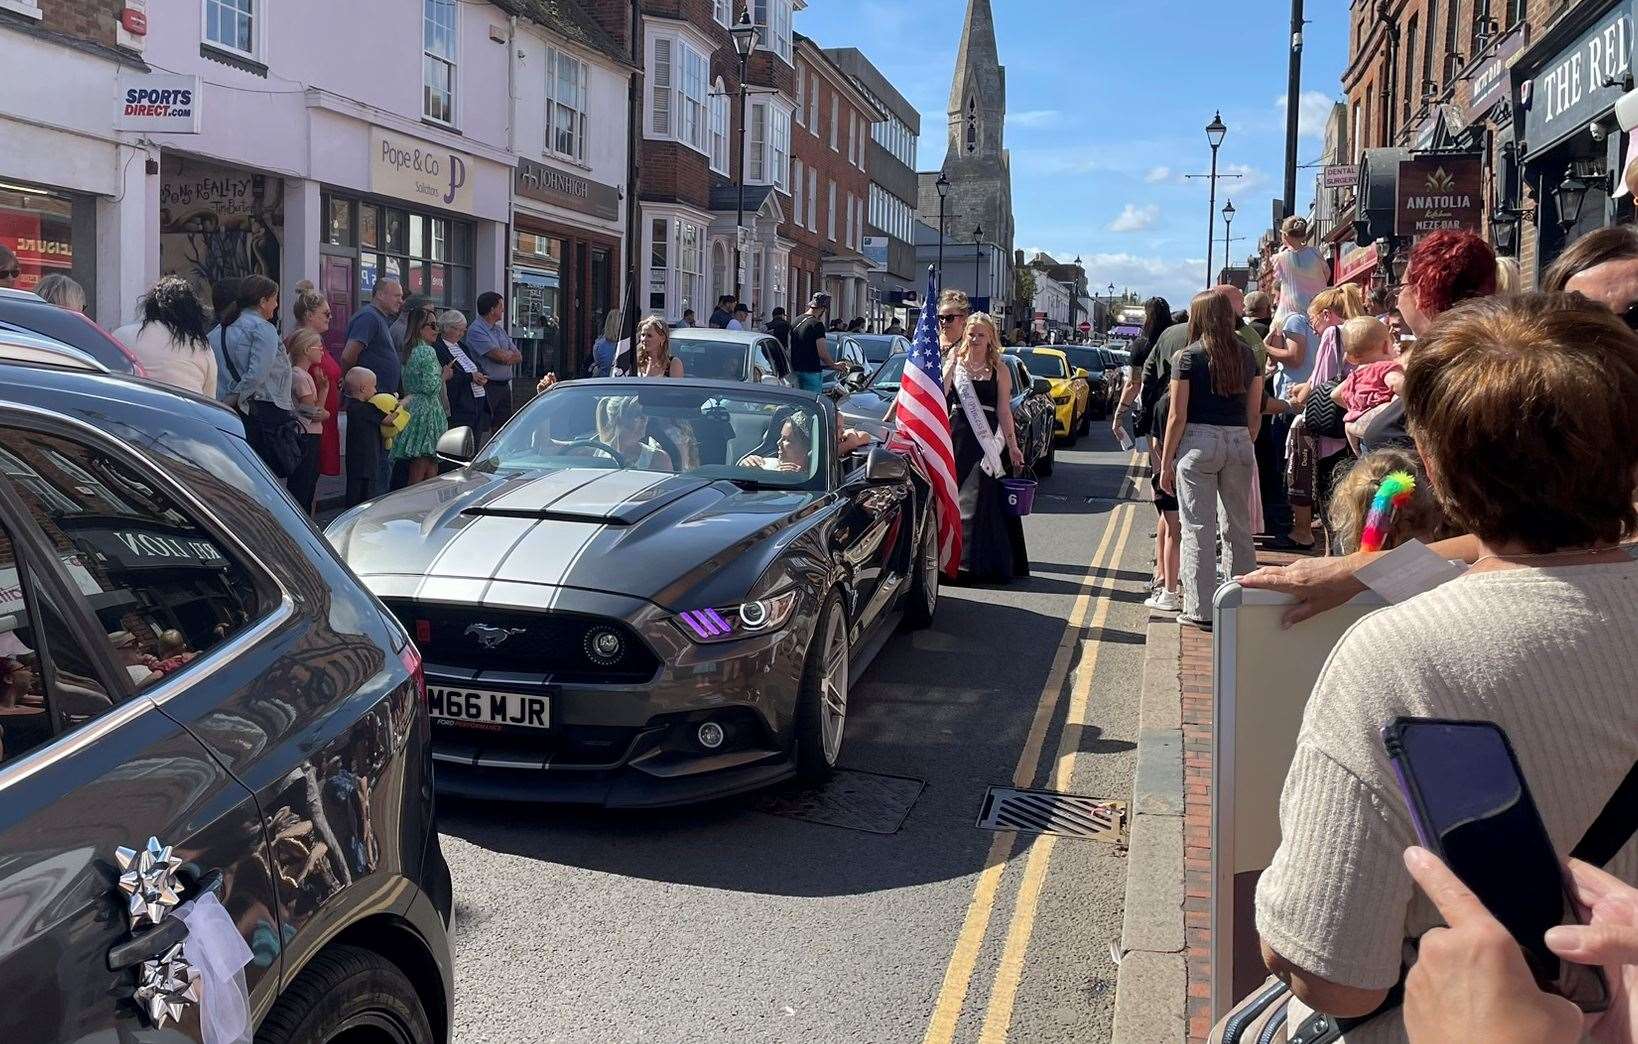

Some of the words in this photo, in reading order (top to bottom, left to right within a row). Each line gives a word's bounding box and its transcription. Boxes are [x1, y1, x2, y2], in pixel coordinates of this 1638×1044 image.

[1543, 51, 1581, 123] THE
[125, 88, 192, 105] SPORTS
[124, 104, 191, 117] DIRECT.COM
[382, 139, 411, 172] Pope
[413, 148, 423, 172] &
[424, 152, 439, 176] Co
[1327, 167, 1357, 175] DENTAL
[1326, 176, 1358, 185] SURGERY
[196, 178, 251, 200] REALITY
[1406, 195, 1471, 209] ANATOLIA
[1415, 220, 1440, 230] MEZE
[1441, 220, 1460, 229] BAR
[1008, 494, 1017, 505] 6
[428, 688, 482, 719] M66
[490, 694, 545, 726] MJR
